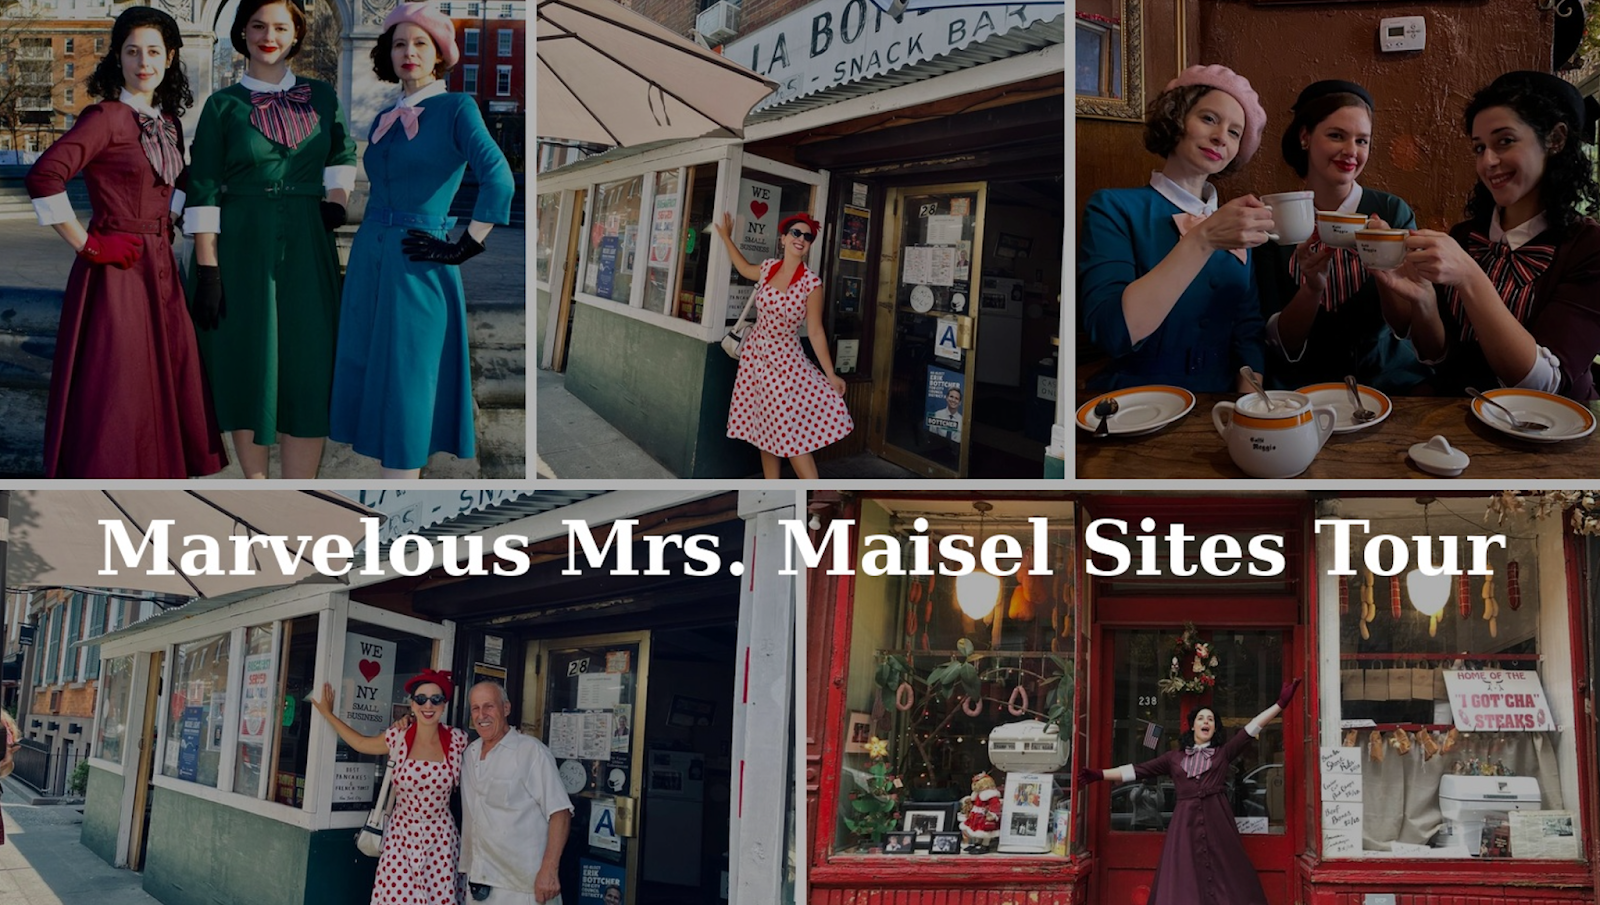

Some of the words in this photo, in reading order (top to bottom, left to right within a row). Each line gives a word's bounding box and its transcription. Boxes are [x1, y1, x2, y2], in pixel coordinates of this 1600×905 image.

[751, 32, 790, 77] LA
[833, 32, 924, 82] SNACK
[752, 186, 770, 200] WE
[920, 204, 936, 216] 28
[748, 222, 766, 234] NY
[744, 236, 767, 245] SMALL
[740, 243, 770, 253] BUSINESS
[939, 325, 957, 349] A
[929, 380, 961, 389] BOTTCHER
[928, 417, 958, 429] BOTTCHER
[360, 642, 382, 658] WE
[569, 660, 588, 675] 28
[1457, 672, 1487, 680] HOME
[1490, 672, 1502, 680] OF
[1505, 672, 1526, 680] THE
[357, 685, 379, 700] NY
[1138, 696, 1157, 706] 238
[352, 702, 380, 713] SMALL
[346, 711, 383, 722] BUSINESS
[1474, 714, 1535, 729] STEAKS
[565, 762, 584, 777] CASH
[560, 772, 580, 786] ONLY
[594, 809, 615, 837] A
[583, 869, 599, 877] ERIK
[582, 877, 621, 886] BOTTCHER
